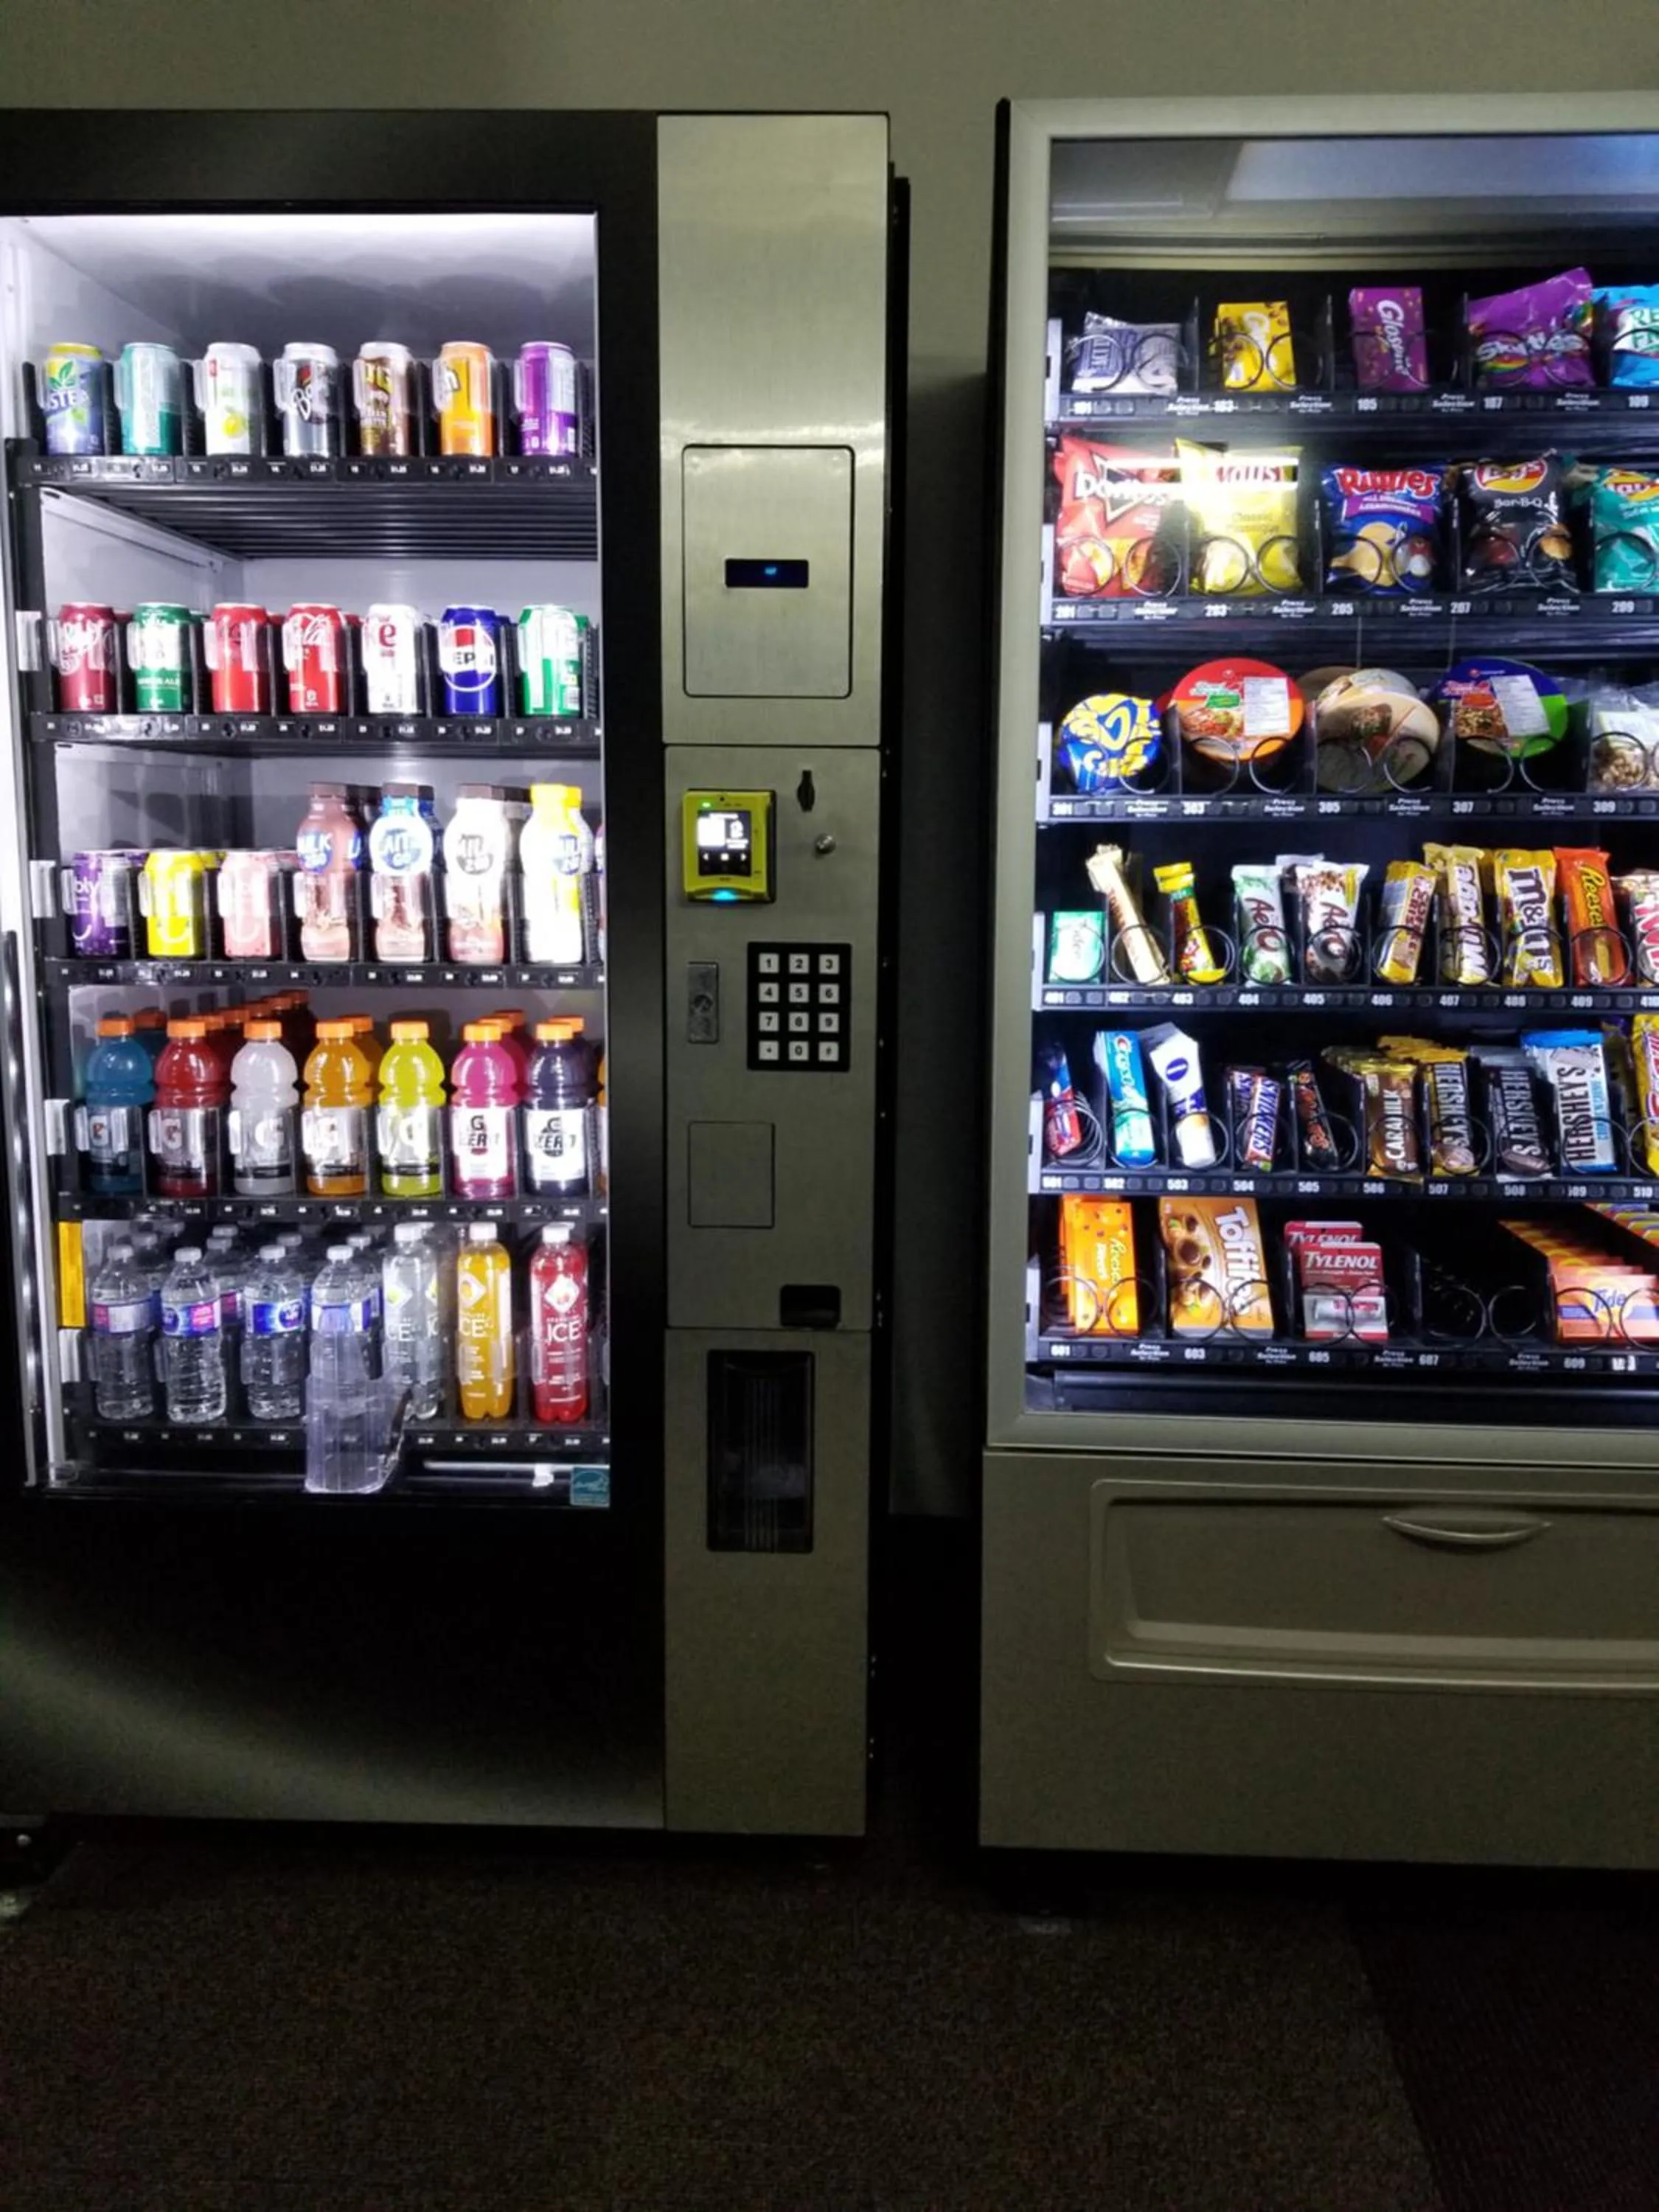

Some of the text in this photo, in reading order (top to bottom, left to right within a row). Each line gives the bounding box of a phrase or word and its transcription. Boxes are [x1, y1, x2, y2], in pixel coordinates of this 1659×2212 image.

[1332, 602, 1354, 616] 205
[1450, 602, 1471, 614] 207
[1612, 602, 1635, 613] 209
[1318, 800, 1340, 814] 305
[1453, 800, 1475, 813] 307
[1593, 801, 1616, 813] 309
[1581, 865, 1605, 933] Reese
[1320, 901, 1348, 959] Aeo
[1172, 992, 1194, 1005] 403
[1238, 992, 1259, 1006] 404
[1303, 992, 1325, 1006] 405
[1371, 994, 1394, 1006] 406
[1439, 994, 1460, 1006] 407
[1571, 995, 1593, 1008] 409
[1166, 1178, 1189, 1191] 503
[1233, 1179, 1255, 1192] 504
[1298, 1180, 1320, 1193] 505
[1363, 1183, 1385, 1194] 506
[1428, 1183, 1449, 1196] 507
[1304, 1251, 1378, 1270] TYLENOL
[1590, 1289, 1627, 1312] Tide
[544, 1320, 583, 1345] ICE
[1309, 1351, 1330, 1364] 605
[1419, 1354, 1440, 1366] 607
